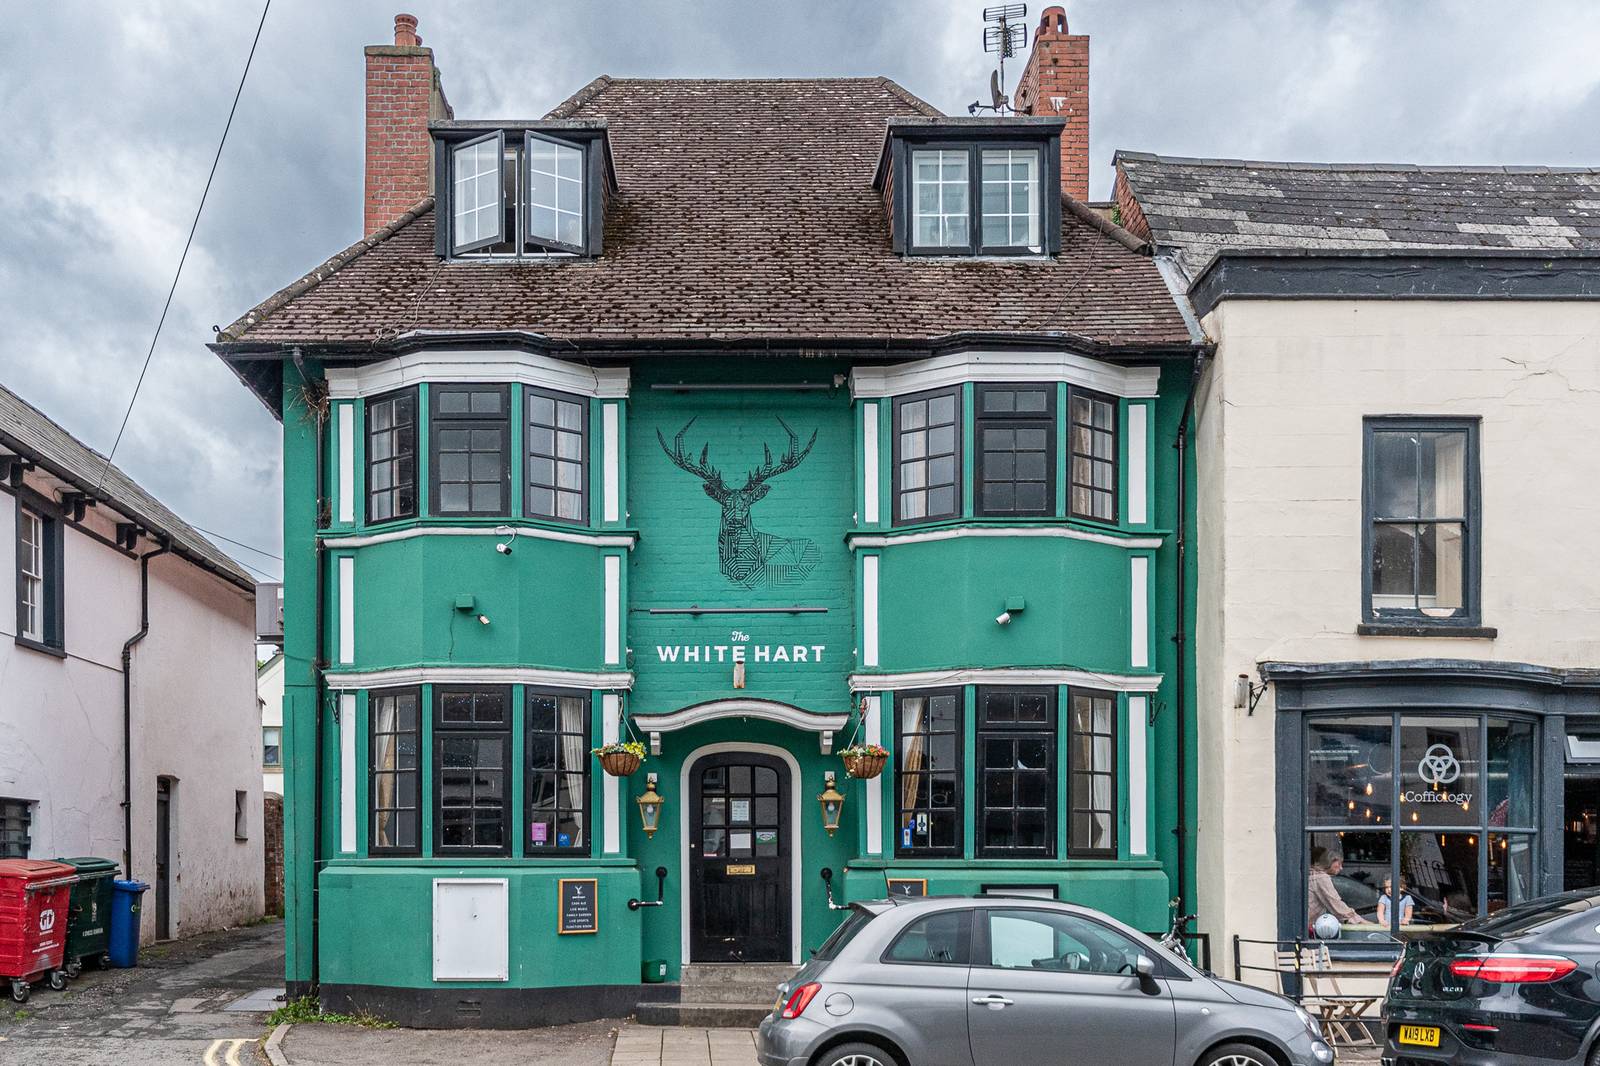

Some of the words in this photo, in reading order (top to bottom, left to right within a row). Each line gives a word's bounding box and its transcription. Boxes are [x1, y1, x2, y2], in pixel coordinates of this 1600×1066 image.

[731, 631, 750, 642] The
[657, 646, 746, 662] WHITE
[754, 646, 825, 662] HART
[1404, 1027, 1419, 1040] WA19
[1420, 1029, 1435, 1042] LXB
